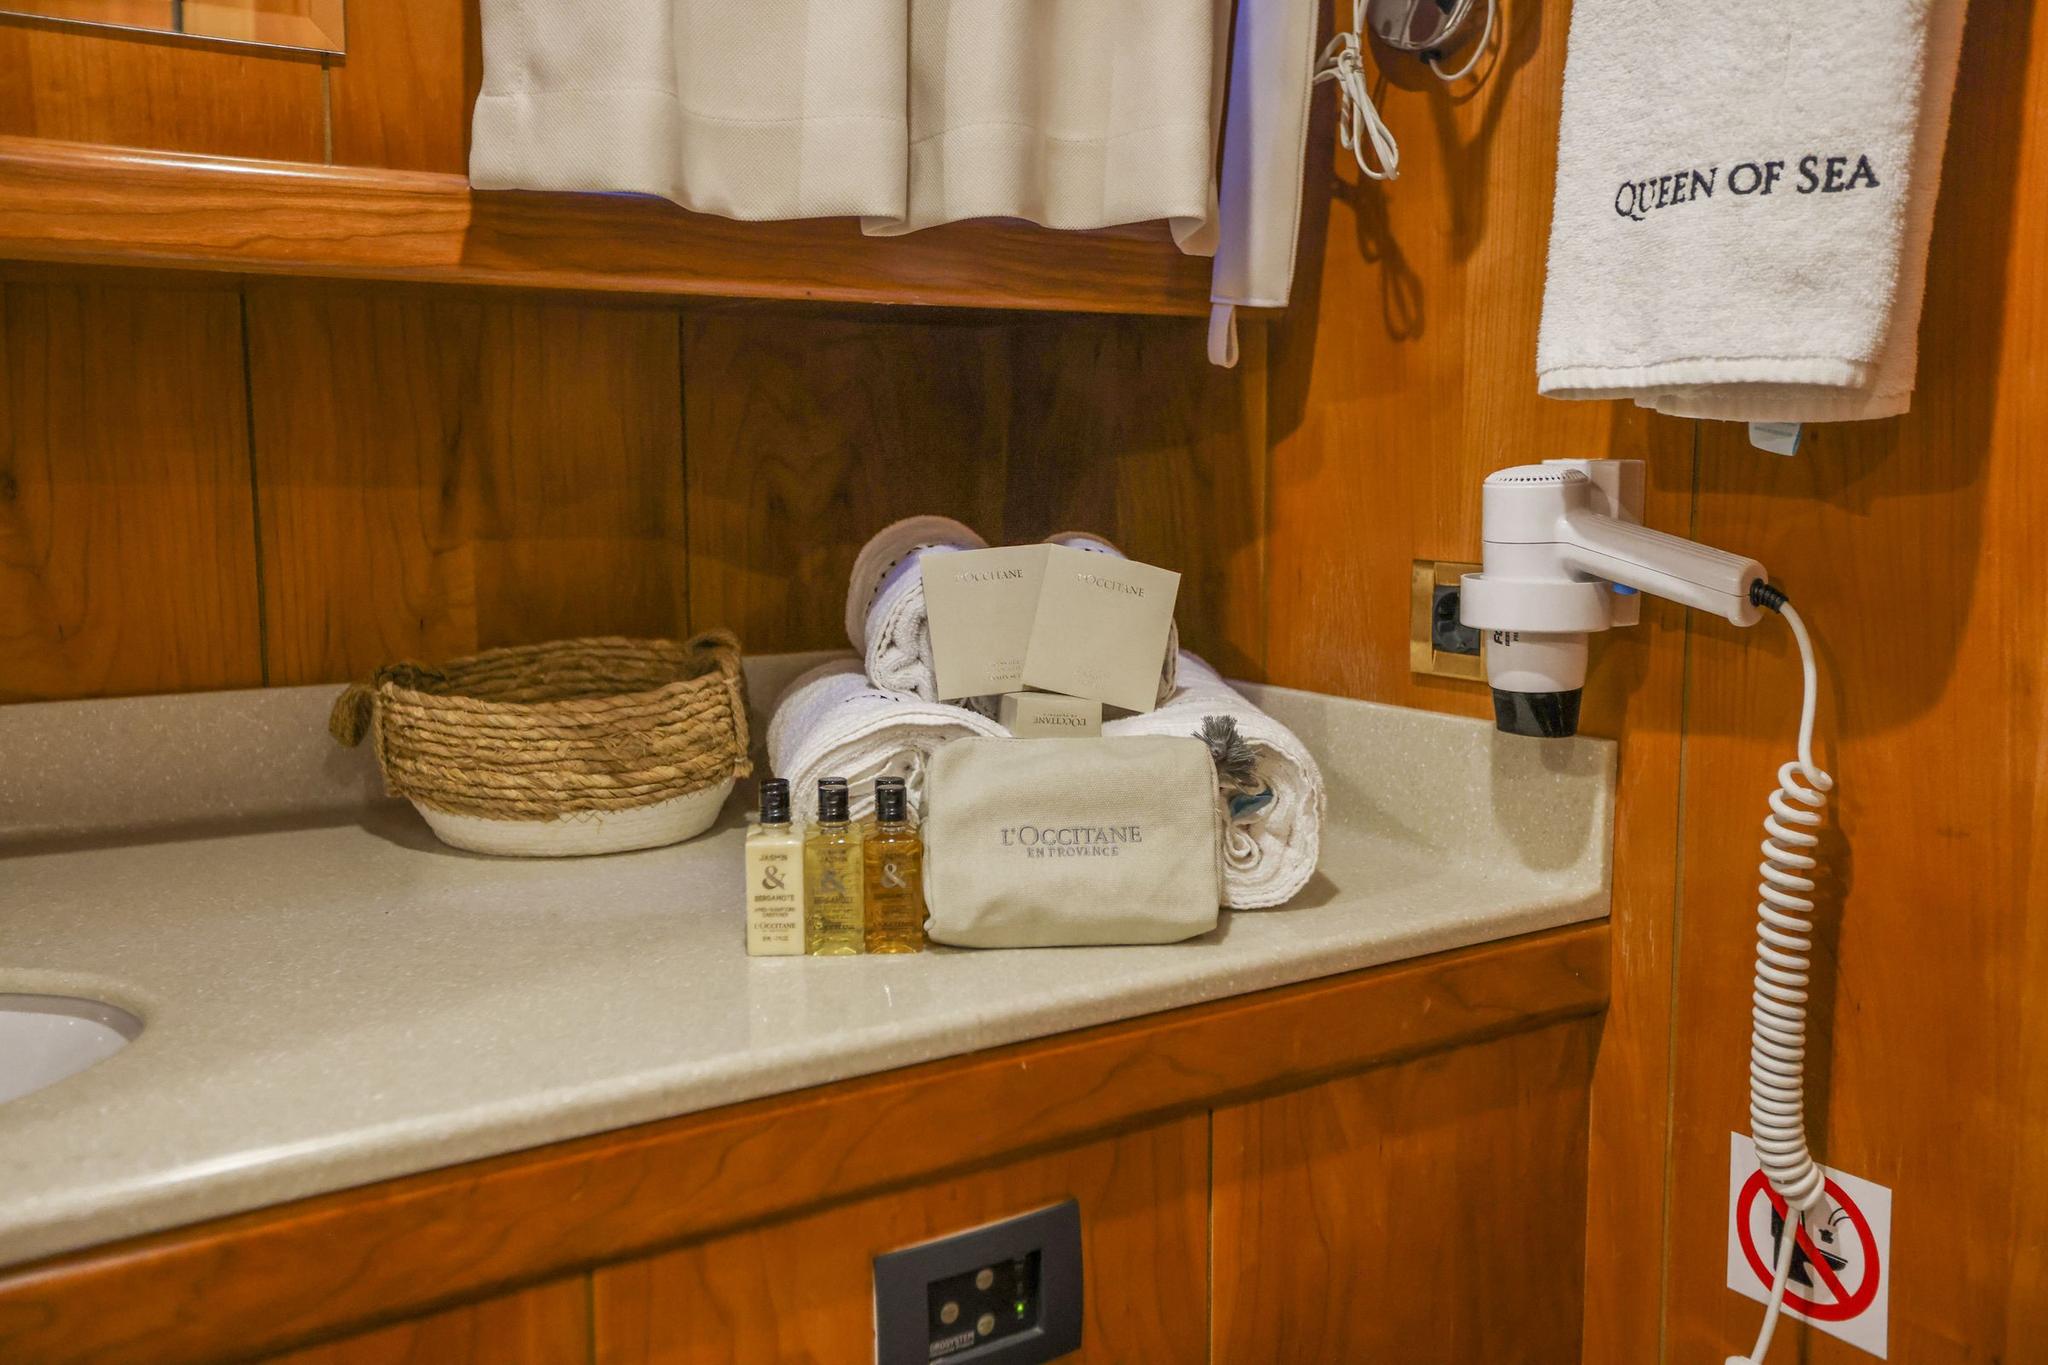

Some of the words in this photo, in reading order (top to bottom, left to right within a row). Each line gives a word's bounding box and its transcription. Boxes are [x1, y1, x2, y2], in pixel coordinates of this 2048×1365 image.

[1615, 167, 1717, 221] QUEEN
[1728, 161, 1784, 195] OF
[1797, 154, 1880, 194] SEA
[1001, 826, 1142, 846] L'OCCITANE
[1027, 847, 1045, 858] EN
[762, 865, 786, 890] &
